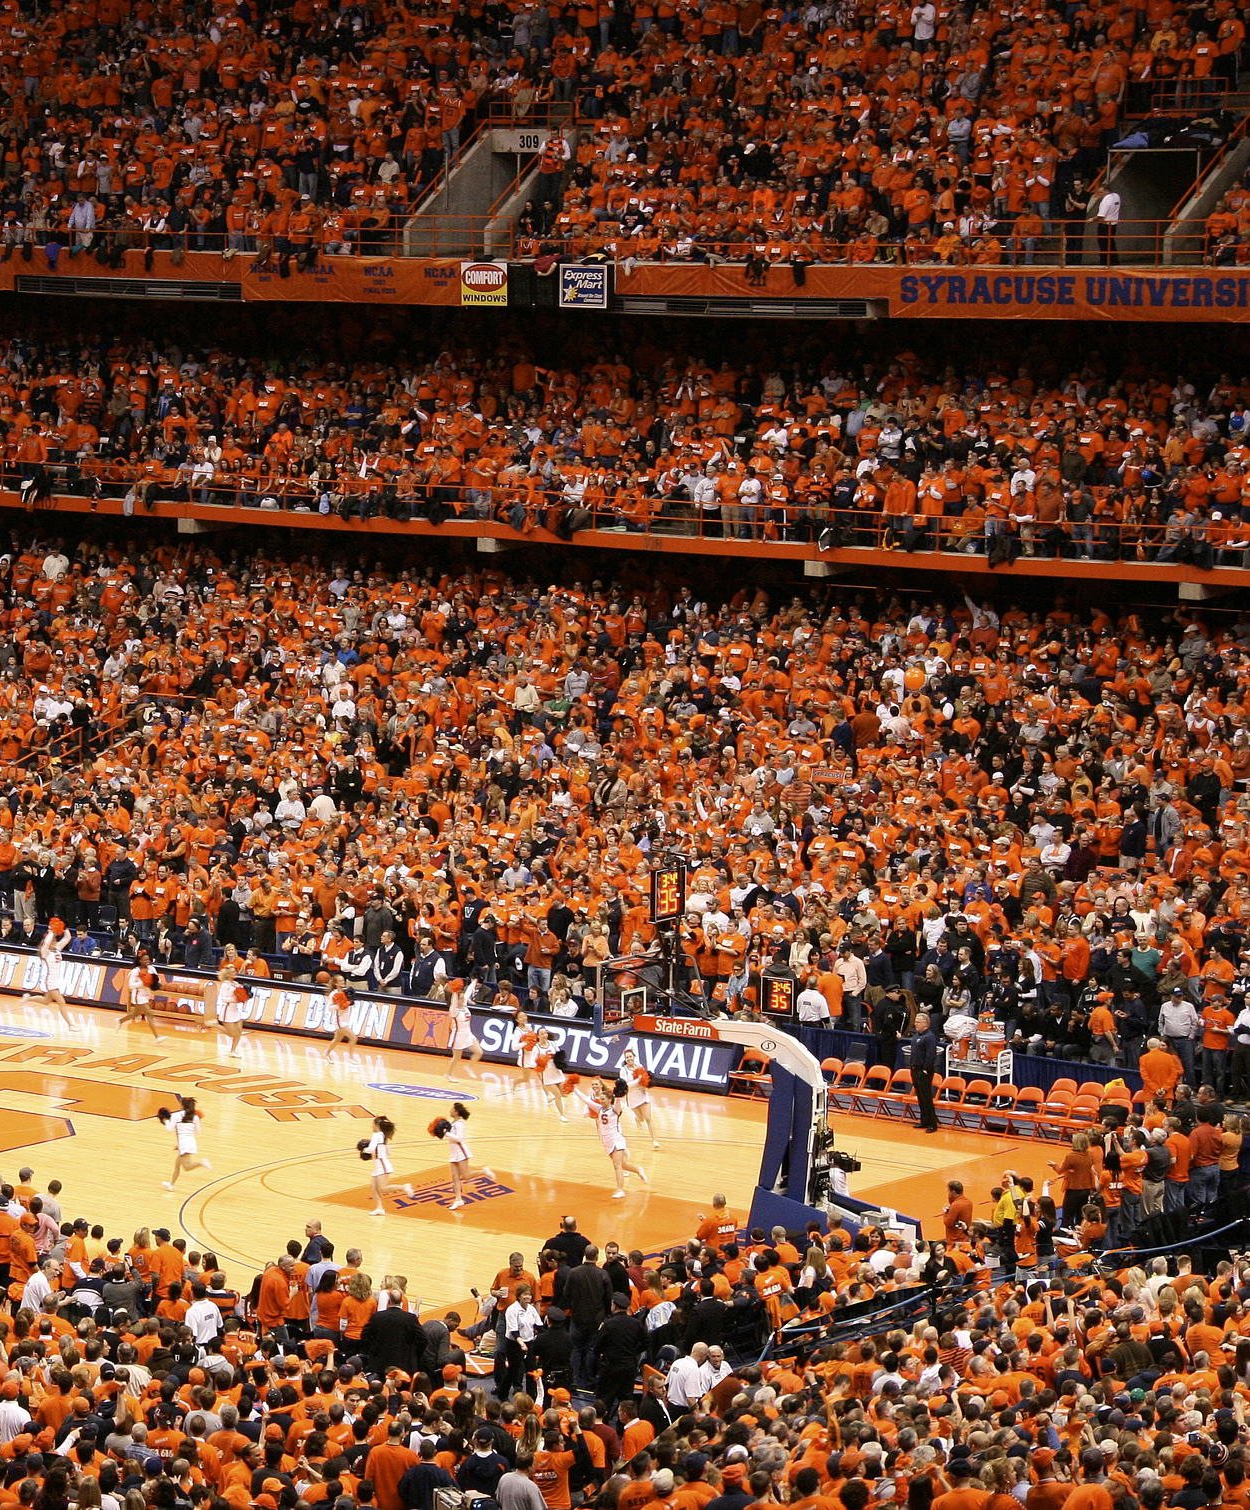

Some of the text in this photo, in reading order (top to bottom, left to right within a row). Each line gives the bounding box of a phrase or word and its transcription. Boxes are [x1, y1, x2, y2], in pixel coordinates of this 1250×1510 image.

[519, 135, 539, 148] 309
[307, 264, 335, 274] NCAA
[363, 267, 394, 277] NCAA
[424, 268, 456, 278] NCAA
[564, 270, 603, 280] Express
[465, 270, 504, 285] COMFORT
[576, 280, 603, 289] Mart
[900, 276, 1249, 307] SYRACUSE UNIVERSI
[462, 294, 507, 302] WINDOWS
[660, 888, 678, 914] 35
[464, 907, 474, 919] V
[772, 981, 791, 994] 3:45
[772, 994, 787, 1009] 35
[274, 991, 302, 1025] IT
[601, 1114, 609, 1124] S
[136, 1254, 144, 1266] 4
[628, 1496, 649, 1505] BEST
